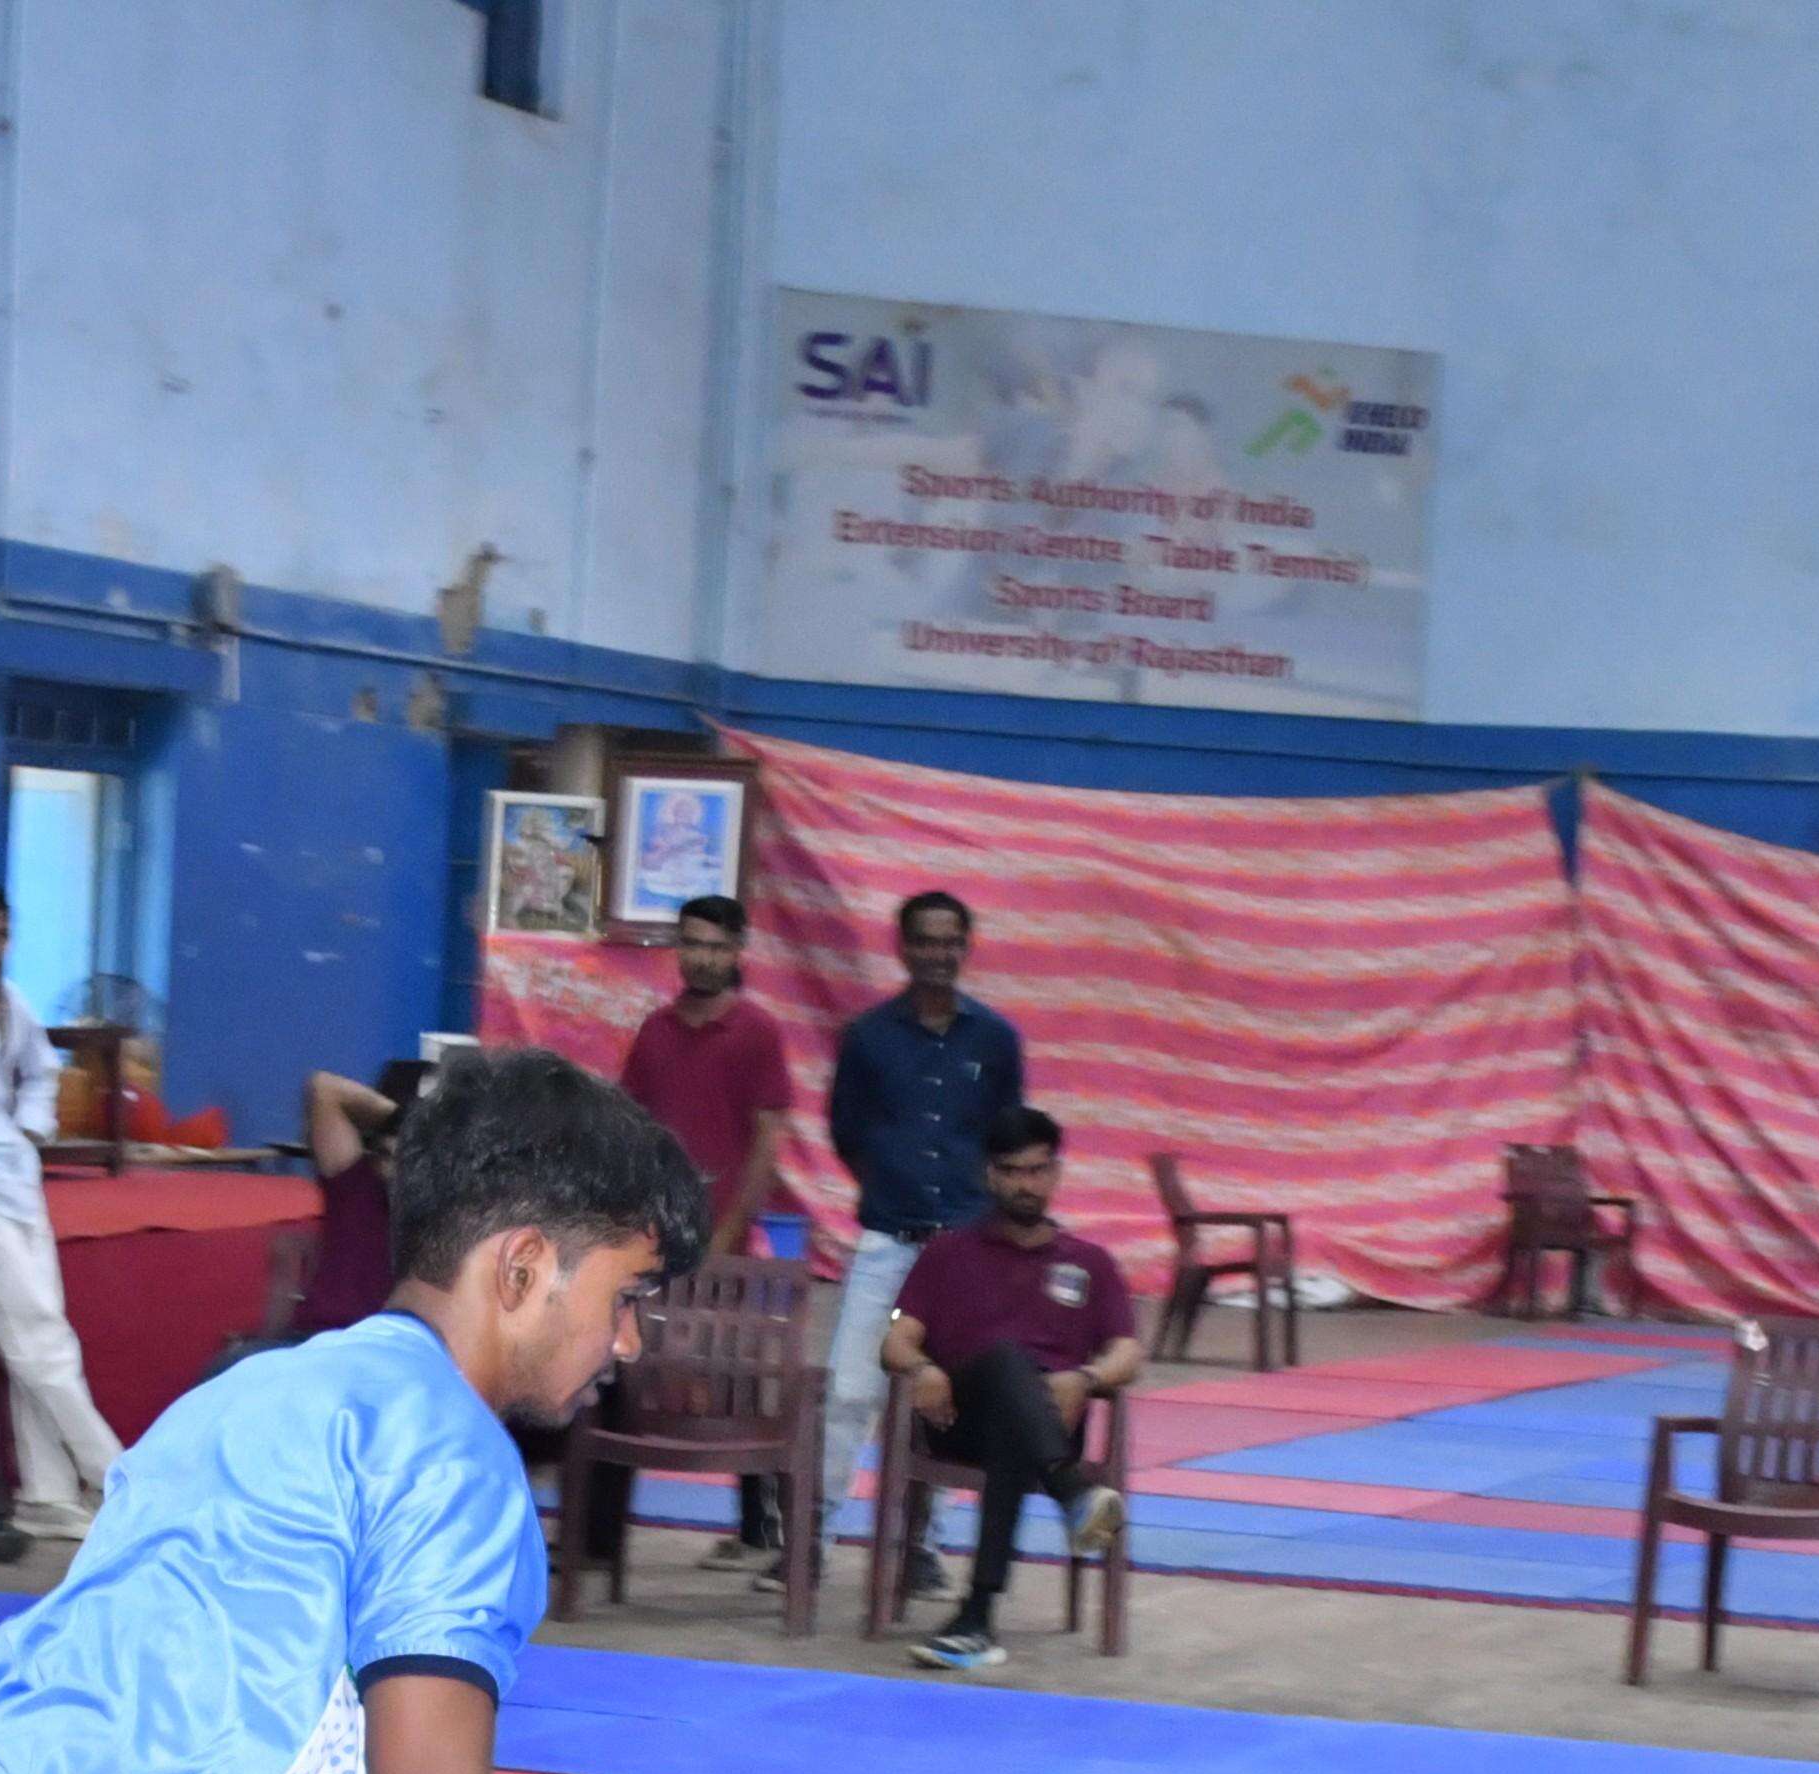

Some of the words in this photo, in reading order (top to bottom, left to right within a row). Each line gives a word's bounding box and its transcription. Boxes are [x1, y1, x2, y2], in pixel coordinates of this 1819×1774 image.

[797, 332, 931, 407] SAI
[901, 463, 1014, 503] Sports
[1028, 478, 1179, 522] Authority
[1186, 489, 1233, 521] of
[1234, 494, 1316, 530] India
[834, 509, 1011, 554] Extension
[995, 575, 1108, 614] Sports
[1114, 583, 1216, 624] Board
[902, 619, 1078, 670] University
[1082, 632, 1123, 664] of
[1126, 636, 1294, 680] Rajasthan
